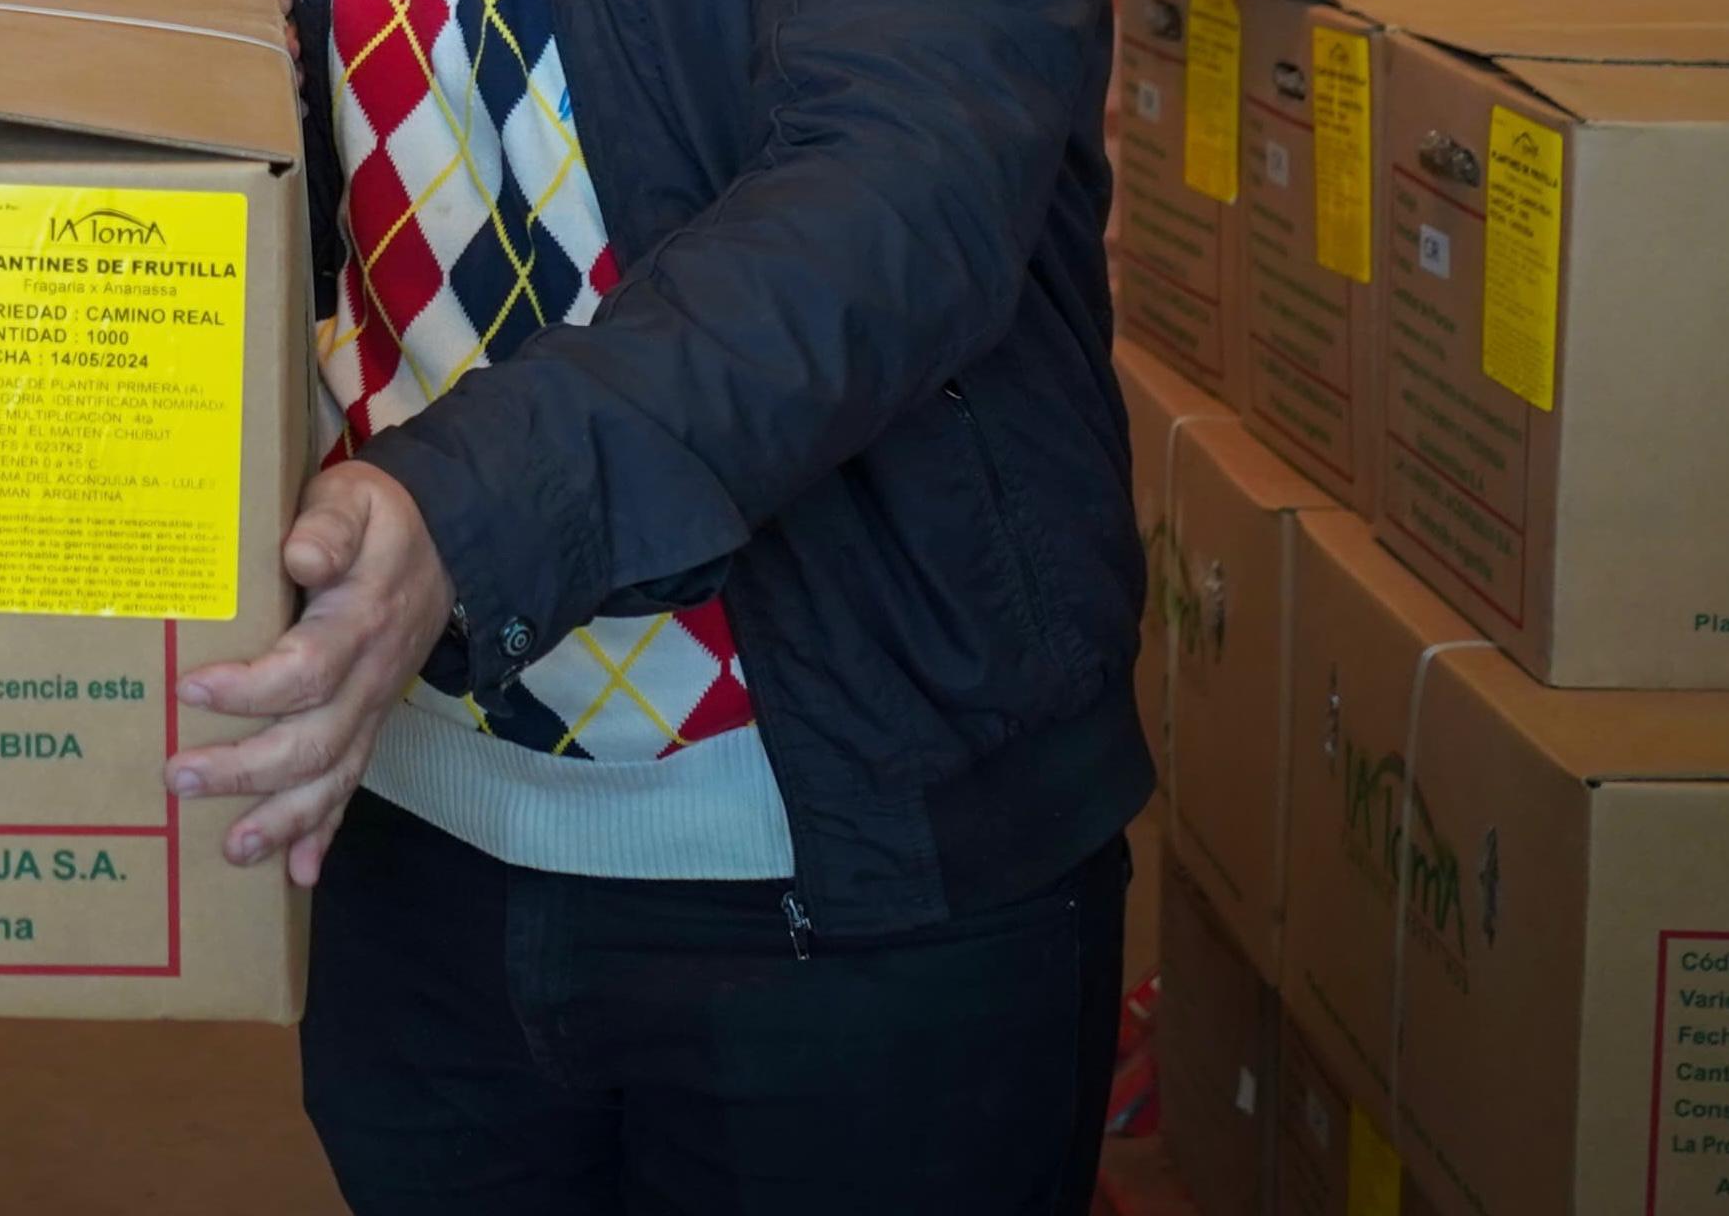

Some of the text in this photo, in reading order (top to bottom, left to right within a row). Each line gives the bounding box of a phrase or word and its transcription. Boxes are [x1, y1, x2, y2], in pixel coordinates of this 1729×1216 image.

[96, 258, 124, 275] DE
[131, 259, 238, 279] FRUTILLA
[23, 278, 178, 297] Fragaria x Ananassa
[86, 306, 167, 324] CAMINO
[173, 309, 226, 326] REAL
[87, 330, 130, 347] 1000
[50, 351, 149, 370] 14/05/2024
[28, 377, 46, 390] DE
[50, 378, 110, 392] PLANTIN
[117, 380, 181, 395] PRIMERA
[52, 394, 149, 409] IDENTIFICADA
[28, 425, 45, 437] EL
[114, 427, 172, 441] CHUBUT
[26, 471, 53, 484] DEL
[56, 473, 138, 488] ACONQUIJA
[43, 488, 123, 502] ARGENTINA
[87, 677, 146, 701] esta
[51, 850, 128, 881] S.A.
[1673, 1136, 1696, 1153] La
